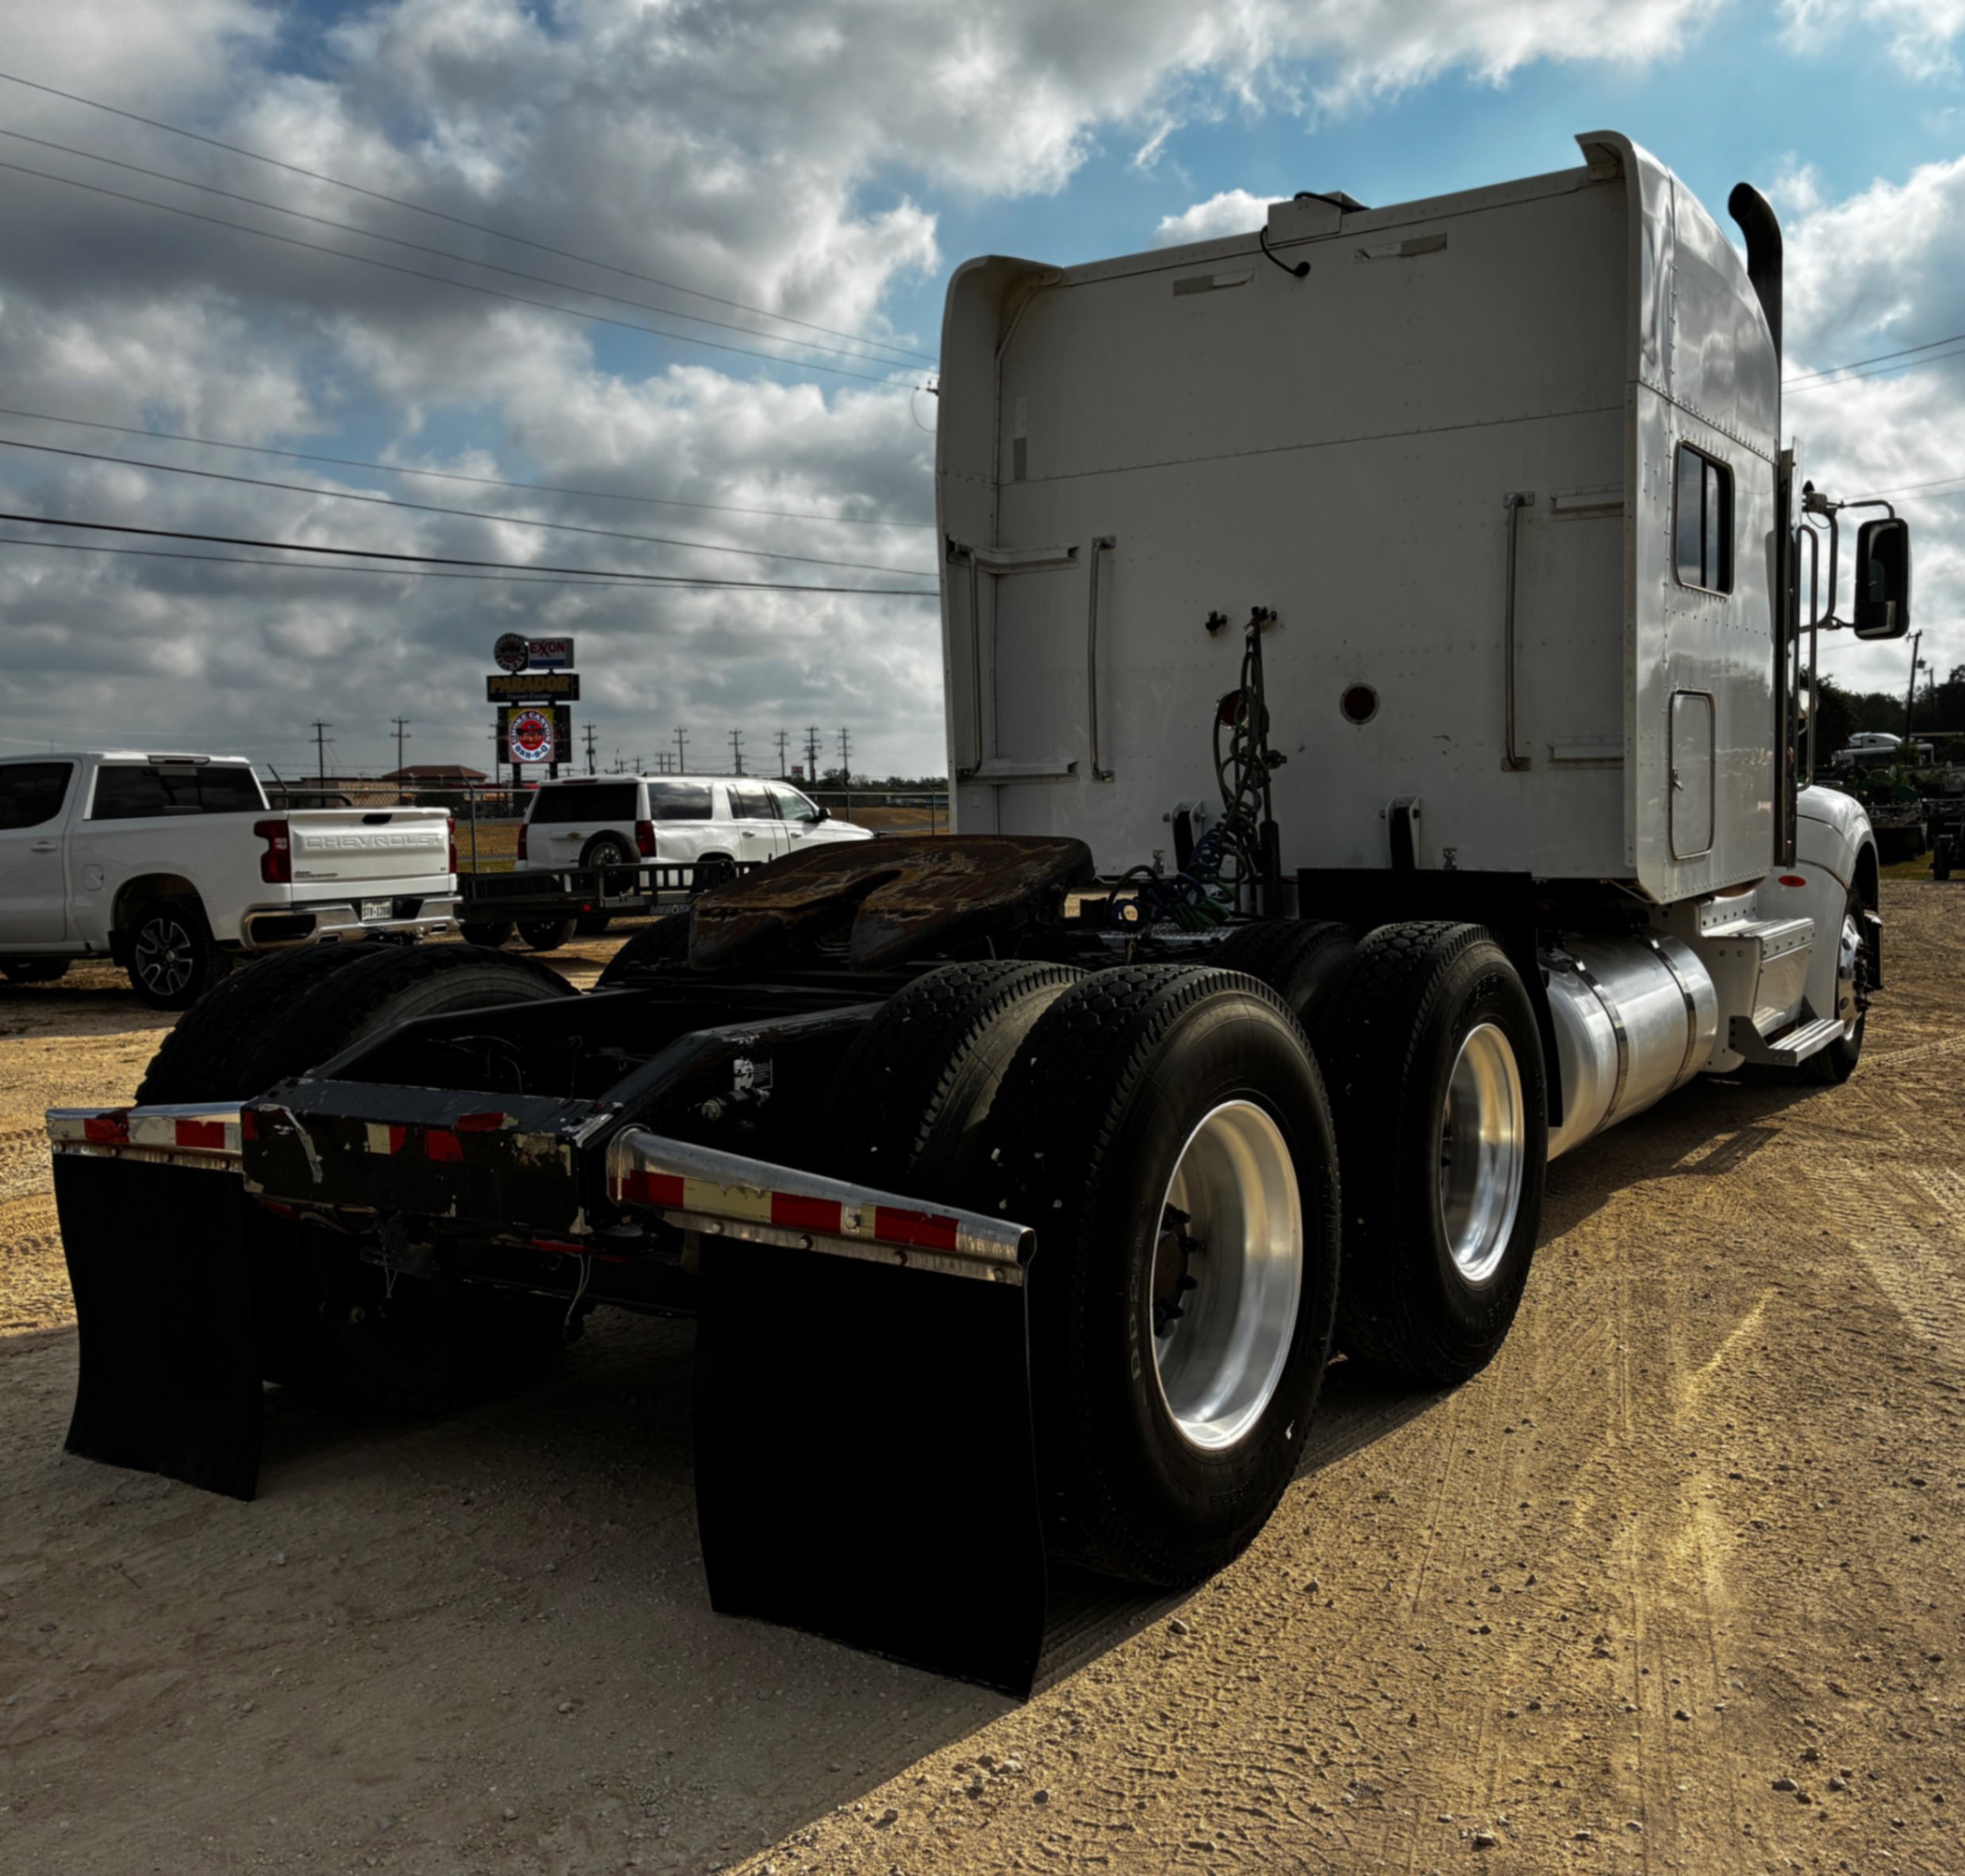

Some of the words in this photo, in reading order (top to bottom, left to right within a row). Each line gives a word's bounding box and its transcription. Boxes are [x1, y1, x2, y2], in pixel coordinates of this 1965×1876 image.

[530, 639, 566, 658] EXXON
[489, 675, 571, 694] PARADOR
[528, 712, 551, 742] CANYON
[304, 832, 443, 850] CHEVROLET
